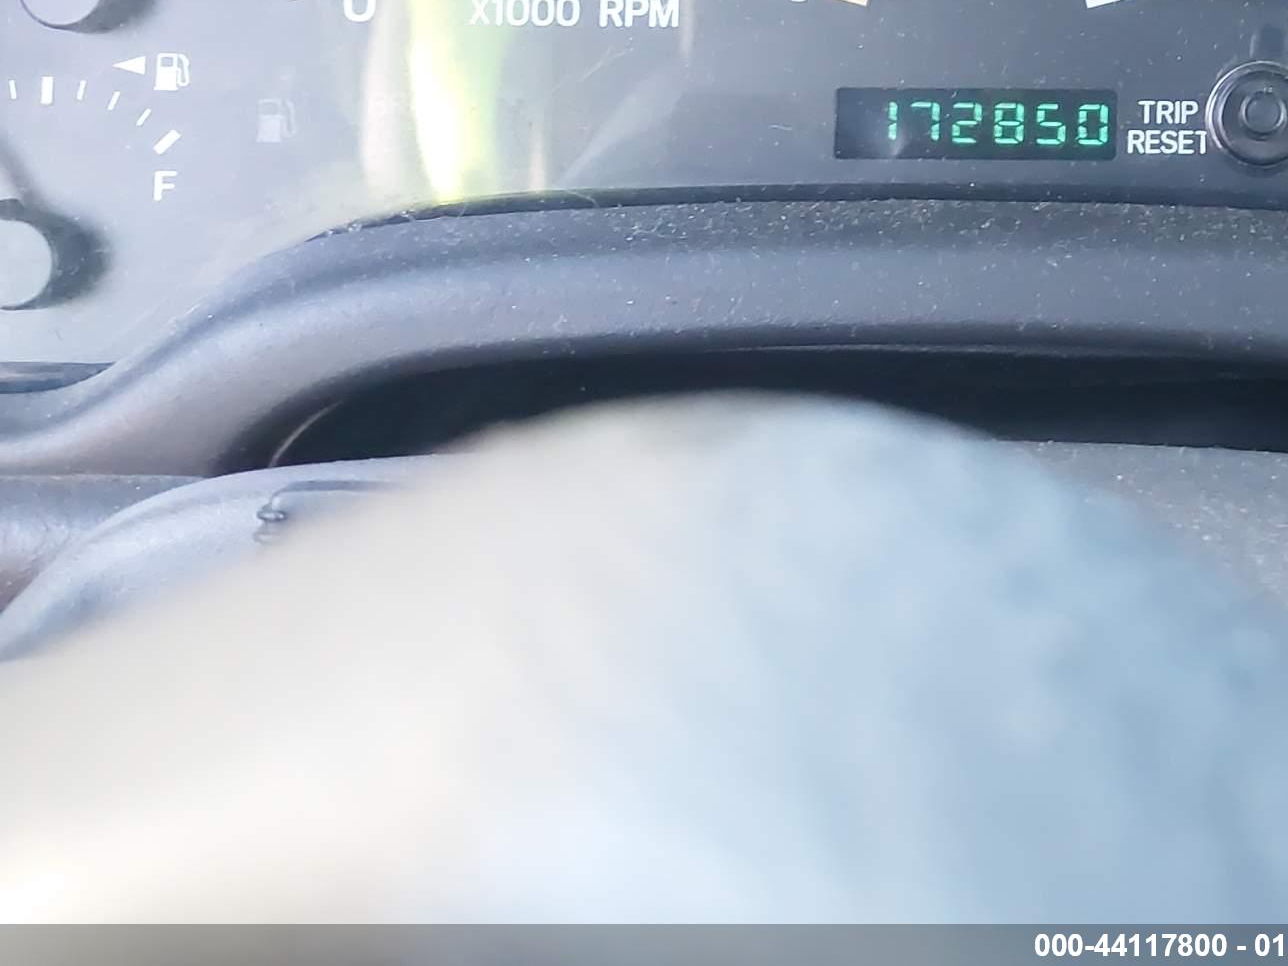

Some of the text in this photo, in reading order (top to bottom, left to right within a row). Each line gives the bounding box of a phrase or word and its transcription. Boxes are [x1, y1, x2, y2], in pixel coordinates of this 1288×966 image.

[885, 100, 1109, 145] 172850
[1138, 100, 1199, 124] TRIP
[1127, 130, 1207, 154] RESET
[154, 170, 177, 200] F
